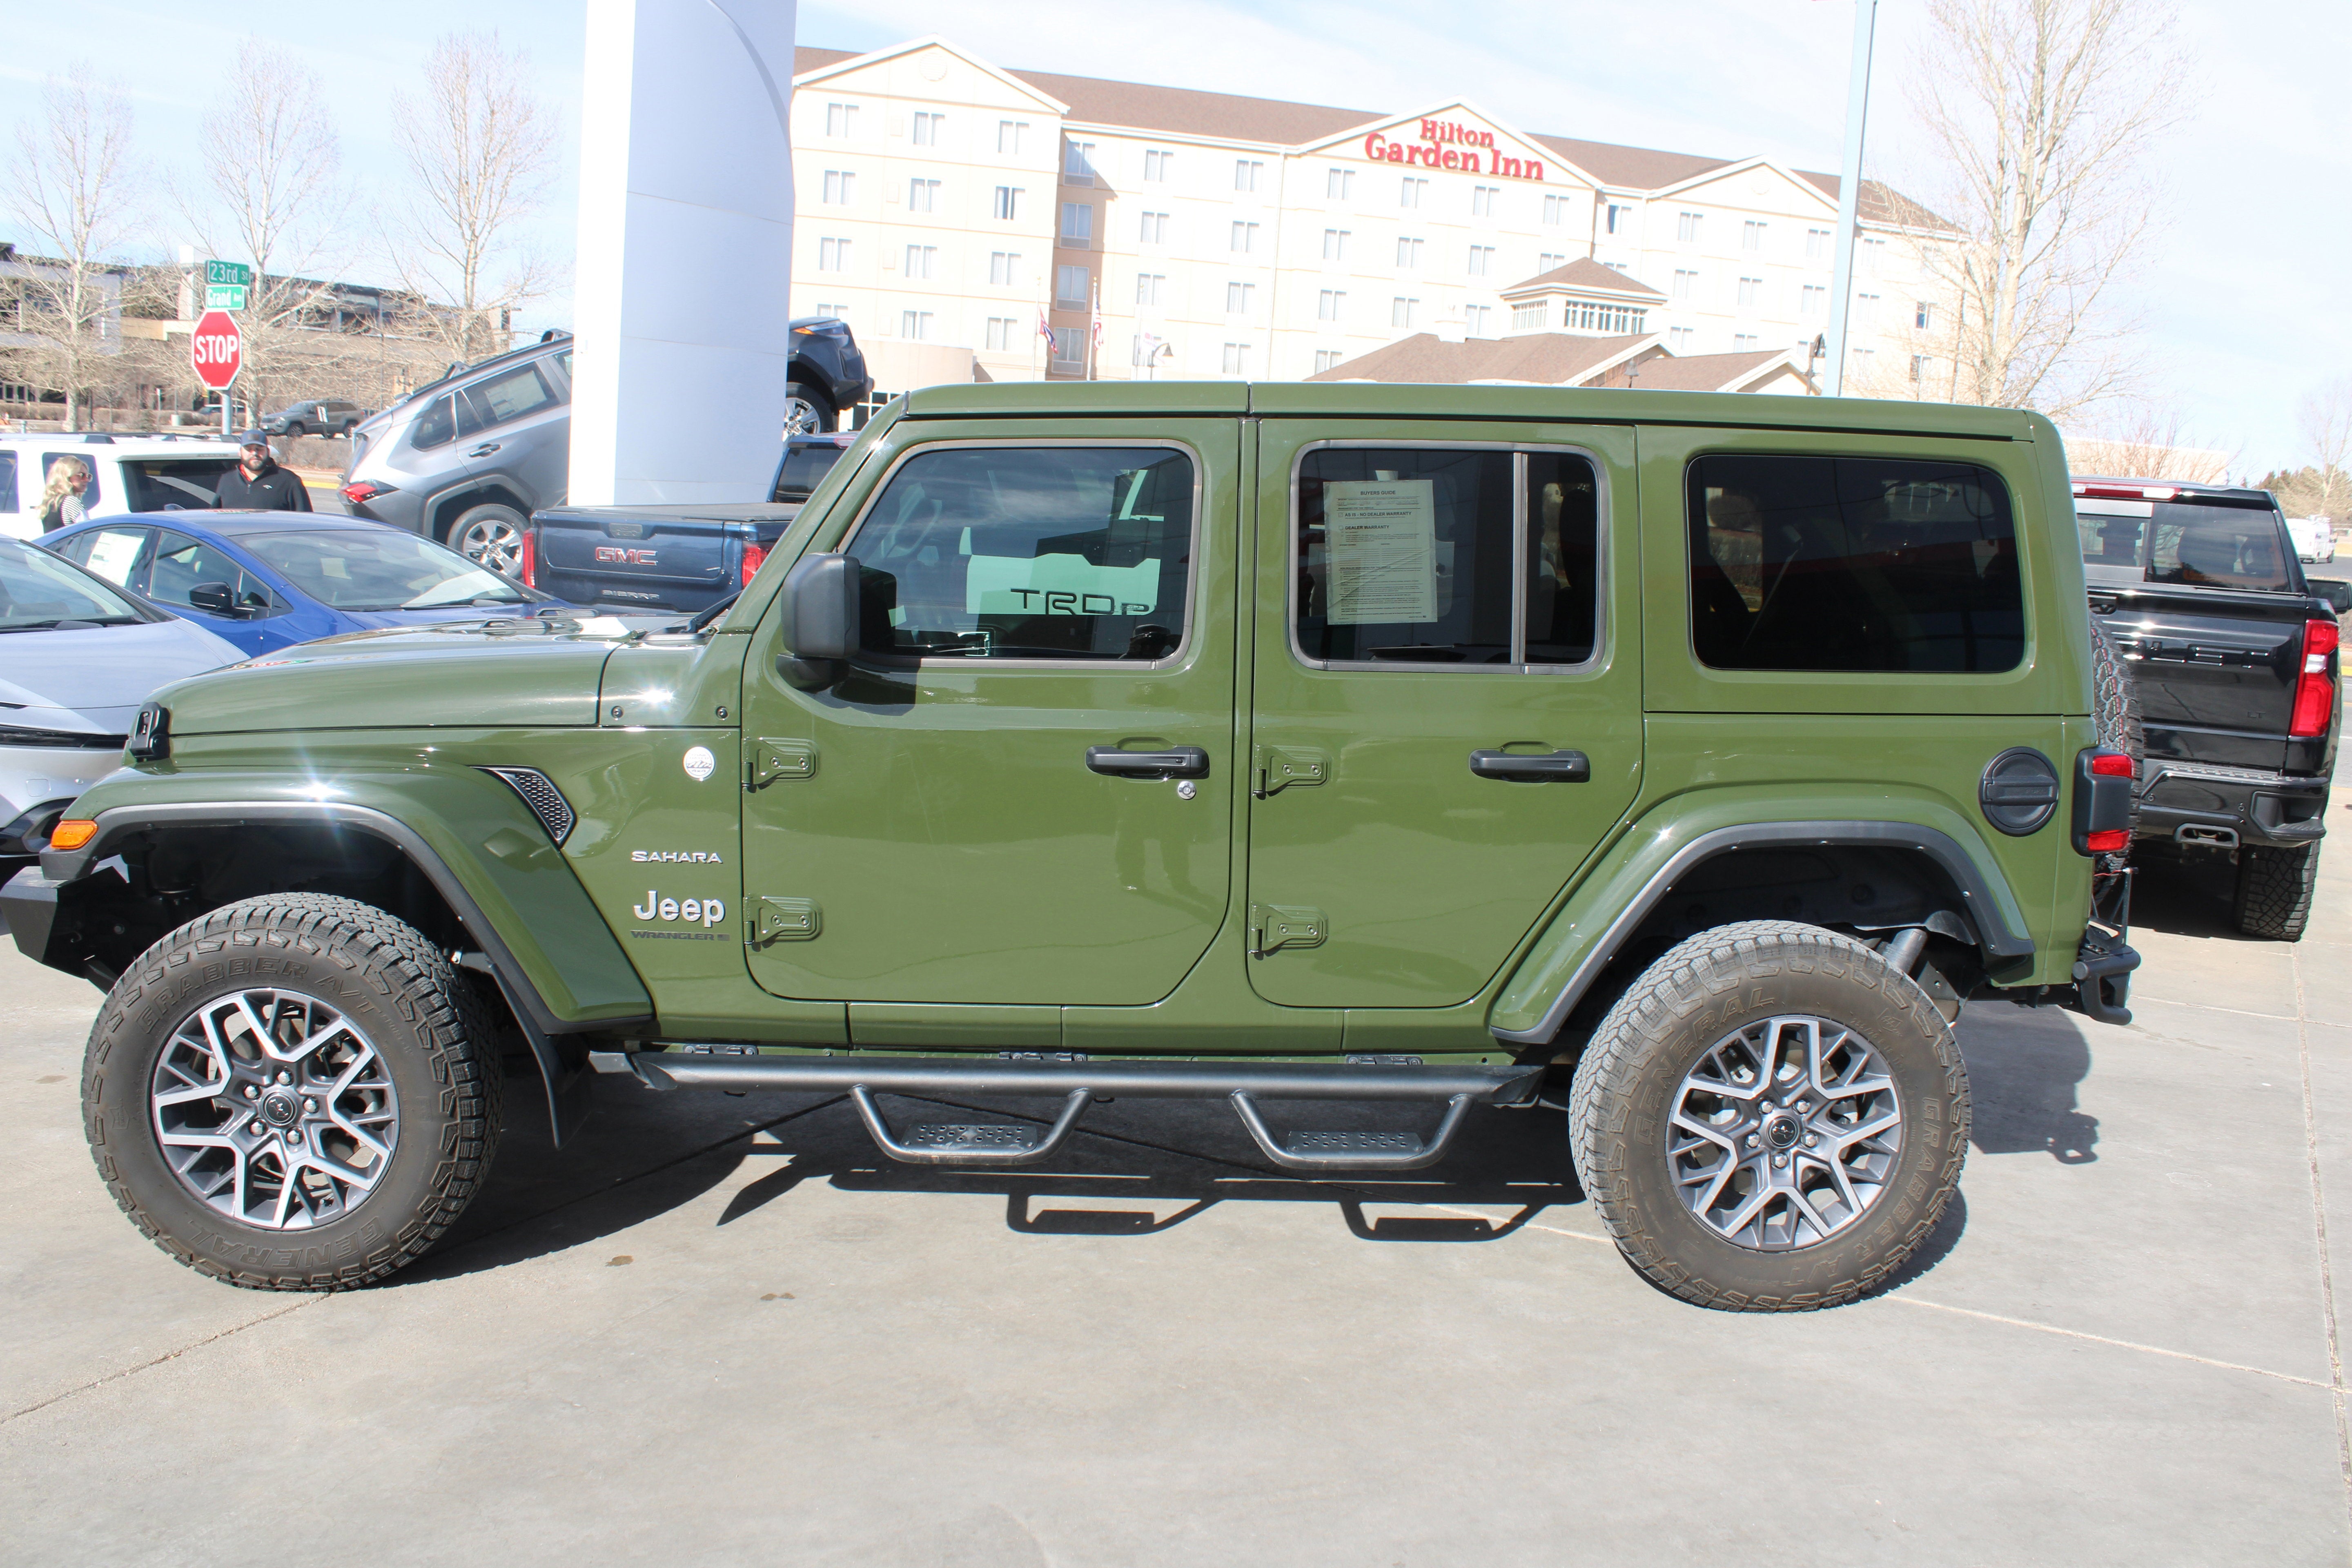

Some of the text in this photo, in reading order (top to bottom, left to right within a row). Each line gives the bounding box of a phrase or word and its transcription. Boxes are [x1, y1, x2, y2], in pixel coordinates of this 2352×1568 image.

[1420, 118, 1494, 148] Hilton
[1365, 132, 1544, 180] Garden Inn
[210, 262, 238, 283] 23rd
[207, 288, 242, 307] Grand Ave
[196, 335, 238, 364] STOP
[595, 546, 658, 566] GMC
[1011, 588, 1115, 615] TRD
[631, 851, 723, 864] SAHARA
[633, 890, 726, 928] Jeep
[630, 931, 715, 940] WRANGLER
[136, 956, 309, 1034] GRABBER
[1634, 987, 1775, 1146] GENERAL
[1853, 1097, 1941, 1262] GRABBER
[188, 1216, 385, 1269] GENERAL
